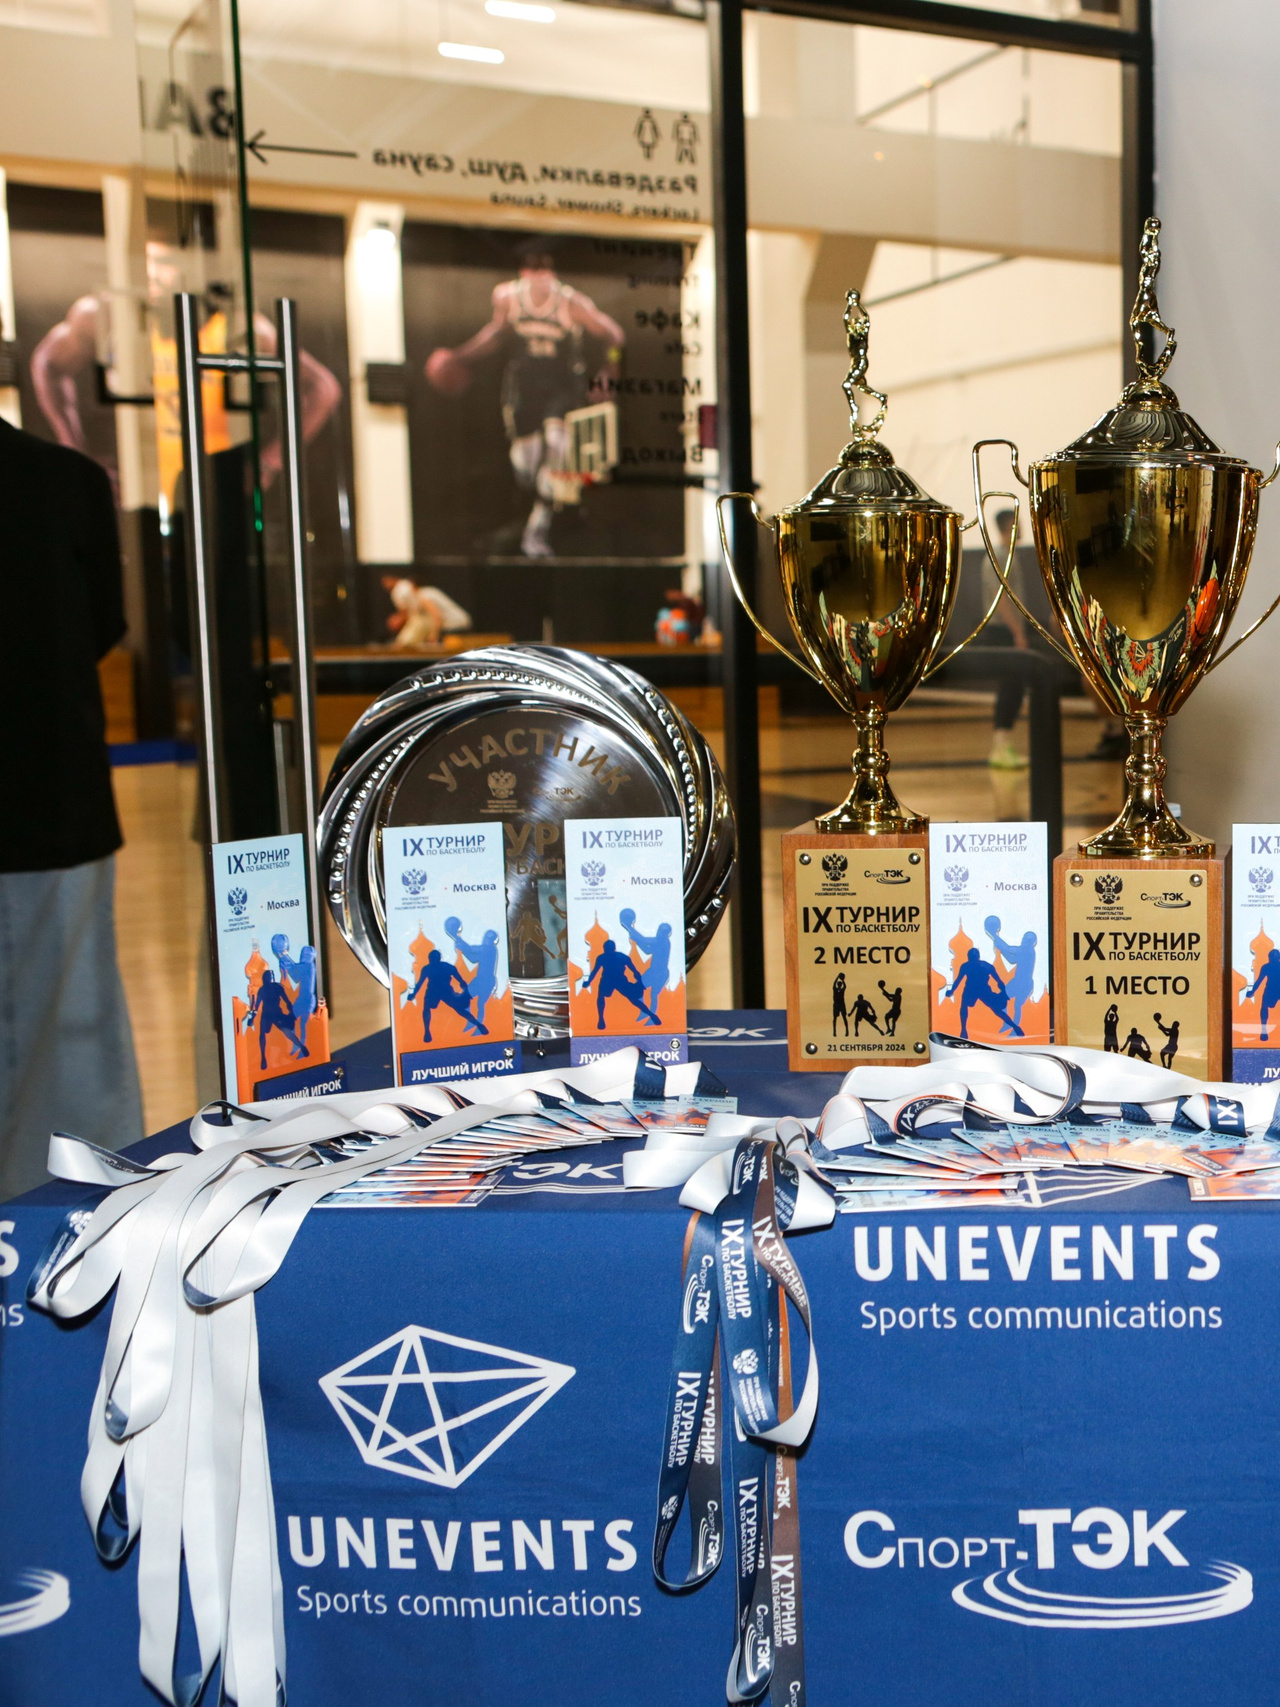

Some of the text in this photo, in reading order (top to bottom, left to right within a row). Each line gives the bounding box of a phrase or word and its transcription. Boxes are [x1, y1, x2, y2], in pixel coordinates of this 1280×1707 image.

[428, 728, 632, 796] УЧАСТНИК
[403, 838, 425, 857] IX
[426, 834, 485, 849] ТУРНИР
[582, 829, 663, 849] IX ТУРНИР
[618, 840, 663, 848] БАСКЕТБОЛУ
[946, 834, 1028, 852] IX ТУРНИР
[968, 844, 1028, 852] ПО БАСКЕТБОЛУ
[1251, 836, 1272, 854] IX
[426, 846, 486, 856] ПО БАСКЕТБОЛУ
[227, 848, 290, 876] IX ТУРНИР
[246, 860, 290, 872] ПО БАСКЕТБОЛУ
[453, 882, 496, 893] Москва
[631, 875, 674, 886] Москва
[994, 882, 1038, 891] Москва
[267, 898, 300, 910] Москва
[802, 906, 920, 933] IX ТУРНИР
[836, 923, 920, 933] ПО БАСКЕТБОЛУ
[814, 946, 910, 964] 2 МЕСТО
[1073, 932, 1200, 961] IX ТУРНИР
[1109, 951, 1200, 961] ПО БАСКЕТБОЛУ
[1085, 976, 1190, 995] 1 МЕСТО
[828, 1044, 906, 1052] 21 СЕНТЯБРЯ 2024
[412, 1062, 468, 1081] ЛУЧШИЙ
[472, 1059, 513, 1076] ИГРОК
[310, 1079, 342, 1097] ИГРОК
[901, 1106, 915, 1131] IX
[1217, 1104, 1238, 1125] IX
[752, 1216, 775, 1248] IX
[762, 1246, 772, 1260] ПО
[854, 1224, 1221, 1282] UNEVENTS
[720, 1218, 752, 1318] IX ТУРНИР
[721, 1247, 737, 1320] ПО БАСКЕТБОЛУ
[860, 1300, 1222, 1335] Sports communications
[676, 1372, 702, 1466] IX ТУРНИР
[668, 1399, 683, 1468] ПО БАСКЕТБОЛУ
[699, 1396, 716, 1465] ТУРНИР
[739, 1507, 746, 1521] ПО
[739, 1477, 759, 1574] IX ТУРНИР
[287, 1516, 638, 1572] UNEVENTS
[296, 1585, 642, 1619] Sports communications
[771, 1554, 796, 1646] IX ТУРНИР
[772, 1582, 782, 1647] ПО БАСКЕТБОЛУ
